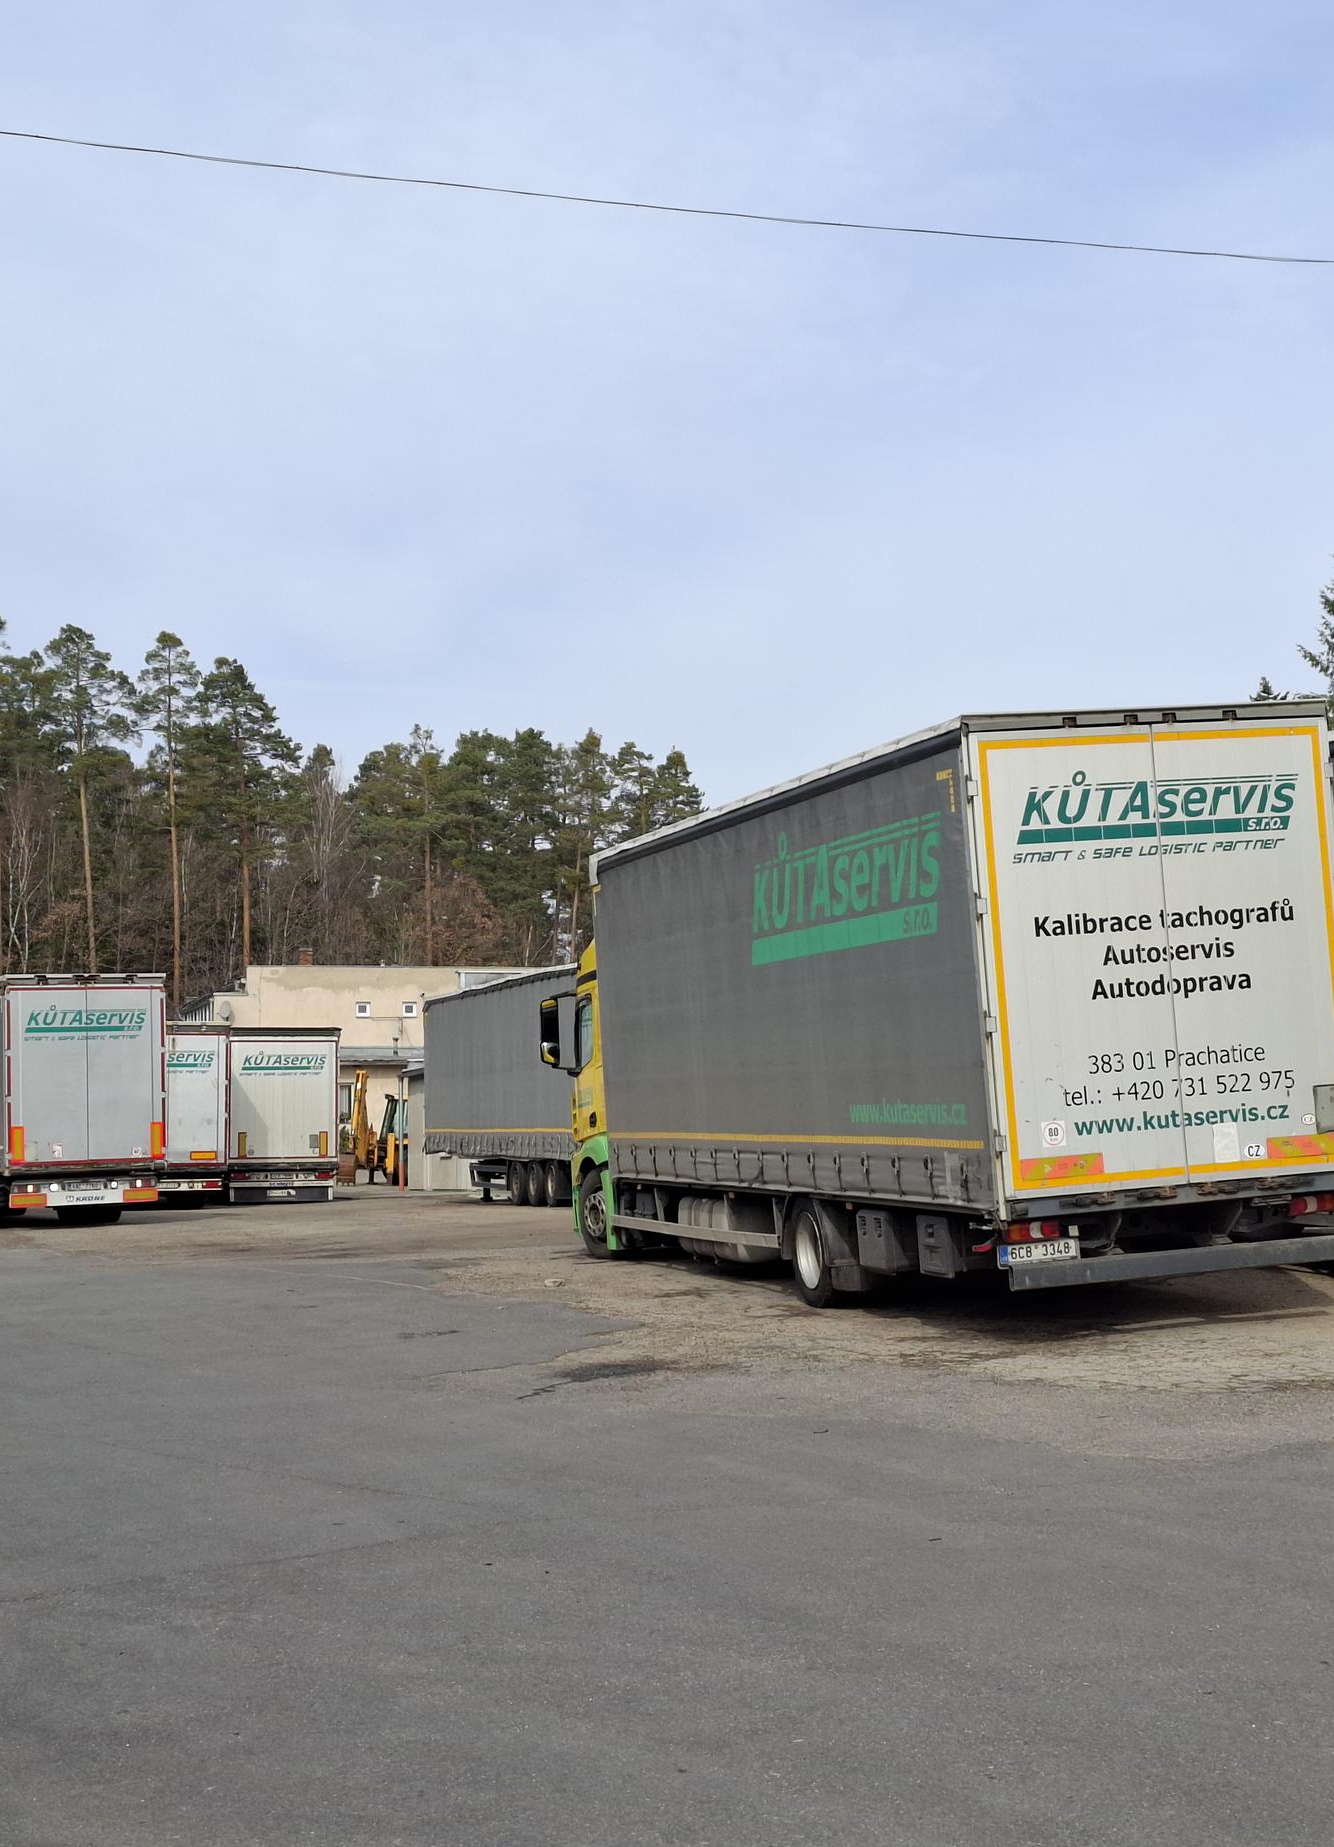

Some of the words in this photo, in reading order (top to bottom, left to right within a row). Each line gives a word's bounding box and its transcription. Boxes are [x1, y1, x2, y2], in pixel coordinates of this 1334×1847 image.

[1021, 770, 1297, 827] KŮTAservis
[1246, 816, 1284, 832] s.r.o.
[1077, 850, 1087, 860] &
[753, 831, 940, 933] KŮTAservis
[1033, 913, 1152, 938] Kalibrace
[1159, 898, 1295, 930] tachografů
[1103, 937, 1235, 966] Autoservis
[1092, 972, 1252, 1000] Autodoprava
[27, 1005, 147, 1026] KŮTAservis
[167, 1052, 214, 1063] servis
[1088, 1053, 1125, 1075] 383
[1133, 1051, 1157, 1072] 01
[1164, 1044, 1266, 1068] Prachatice
[1063, 1085, 1102, 1107] tel.:
[1112, 1079, 1164, 1102] +420
[1171, 1076, 1208, 1099] 731
[1216, 1073, 1252, 1095] 522
[1259, 1069, 1296, 1091] 975
[1048, 1127, 1059, 1137] 80
[1074, 1102, 1290, 1137] www.kutaservis.cz
[1247, 1144, 1261, 1157] CZ
[1010, 1245, 1033, 1260] 6C8
[1042, 1241, 1070, 1257] 3348
